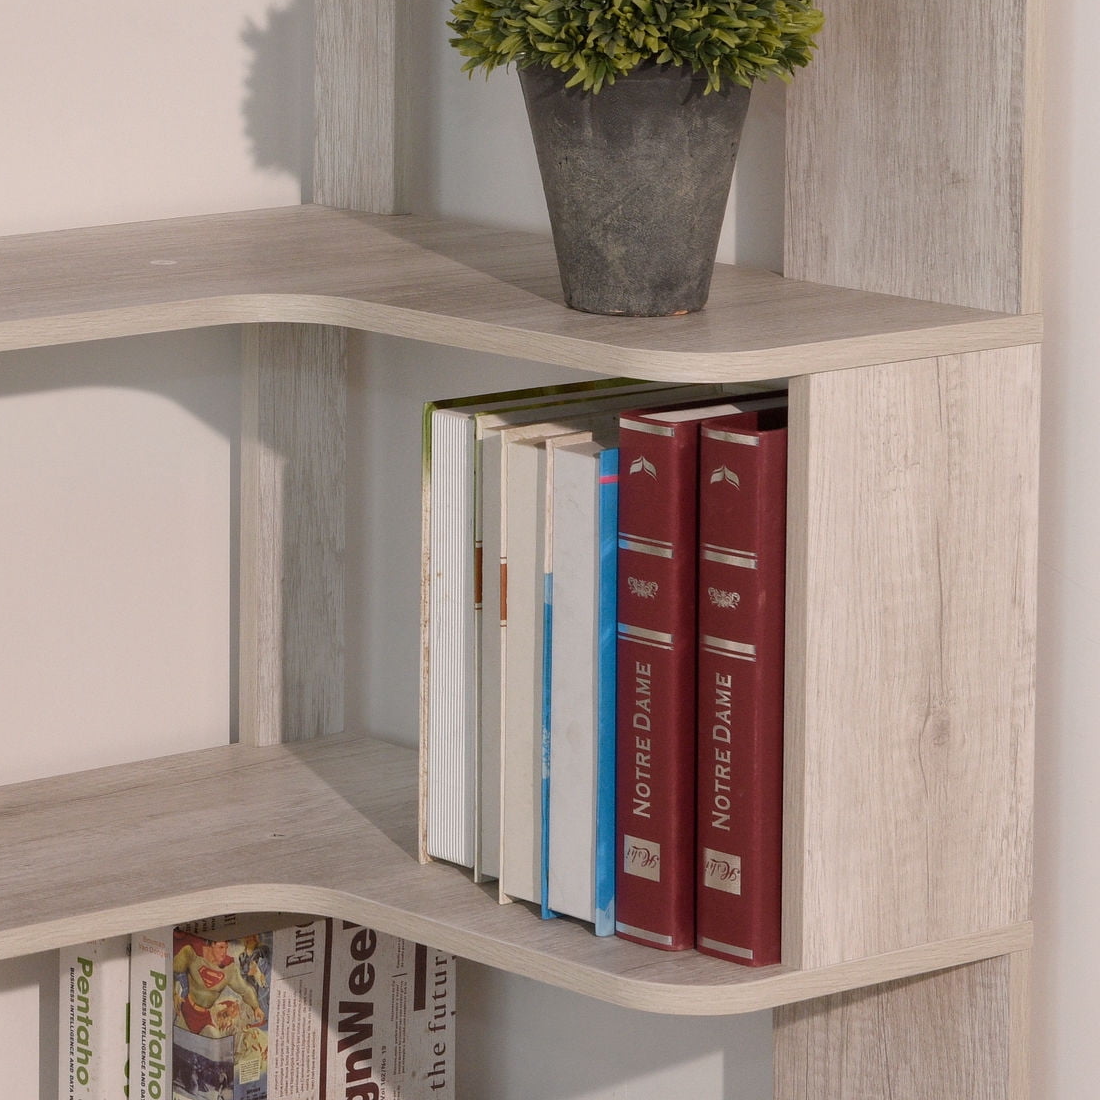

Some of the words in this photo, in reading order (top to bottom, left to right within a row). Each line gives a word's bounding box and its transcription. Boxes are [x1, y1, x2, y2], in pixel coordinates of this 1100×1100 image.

[633, 661, 652, 732] DAME
[712, 672, 732, 745] DAME
[632, 736, 651, 819] NOTRE
[712, 748, 731, 831] NOTRE
[76, 956, 93, 1086] Pentaho
[337, 920, 380, 1100] gnWee
[427, 950, 448, 1033] futur
[148, 970, 167, 1100] Pentaho
[427, 1042, 446, 1091] the
